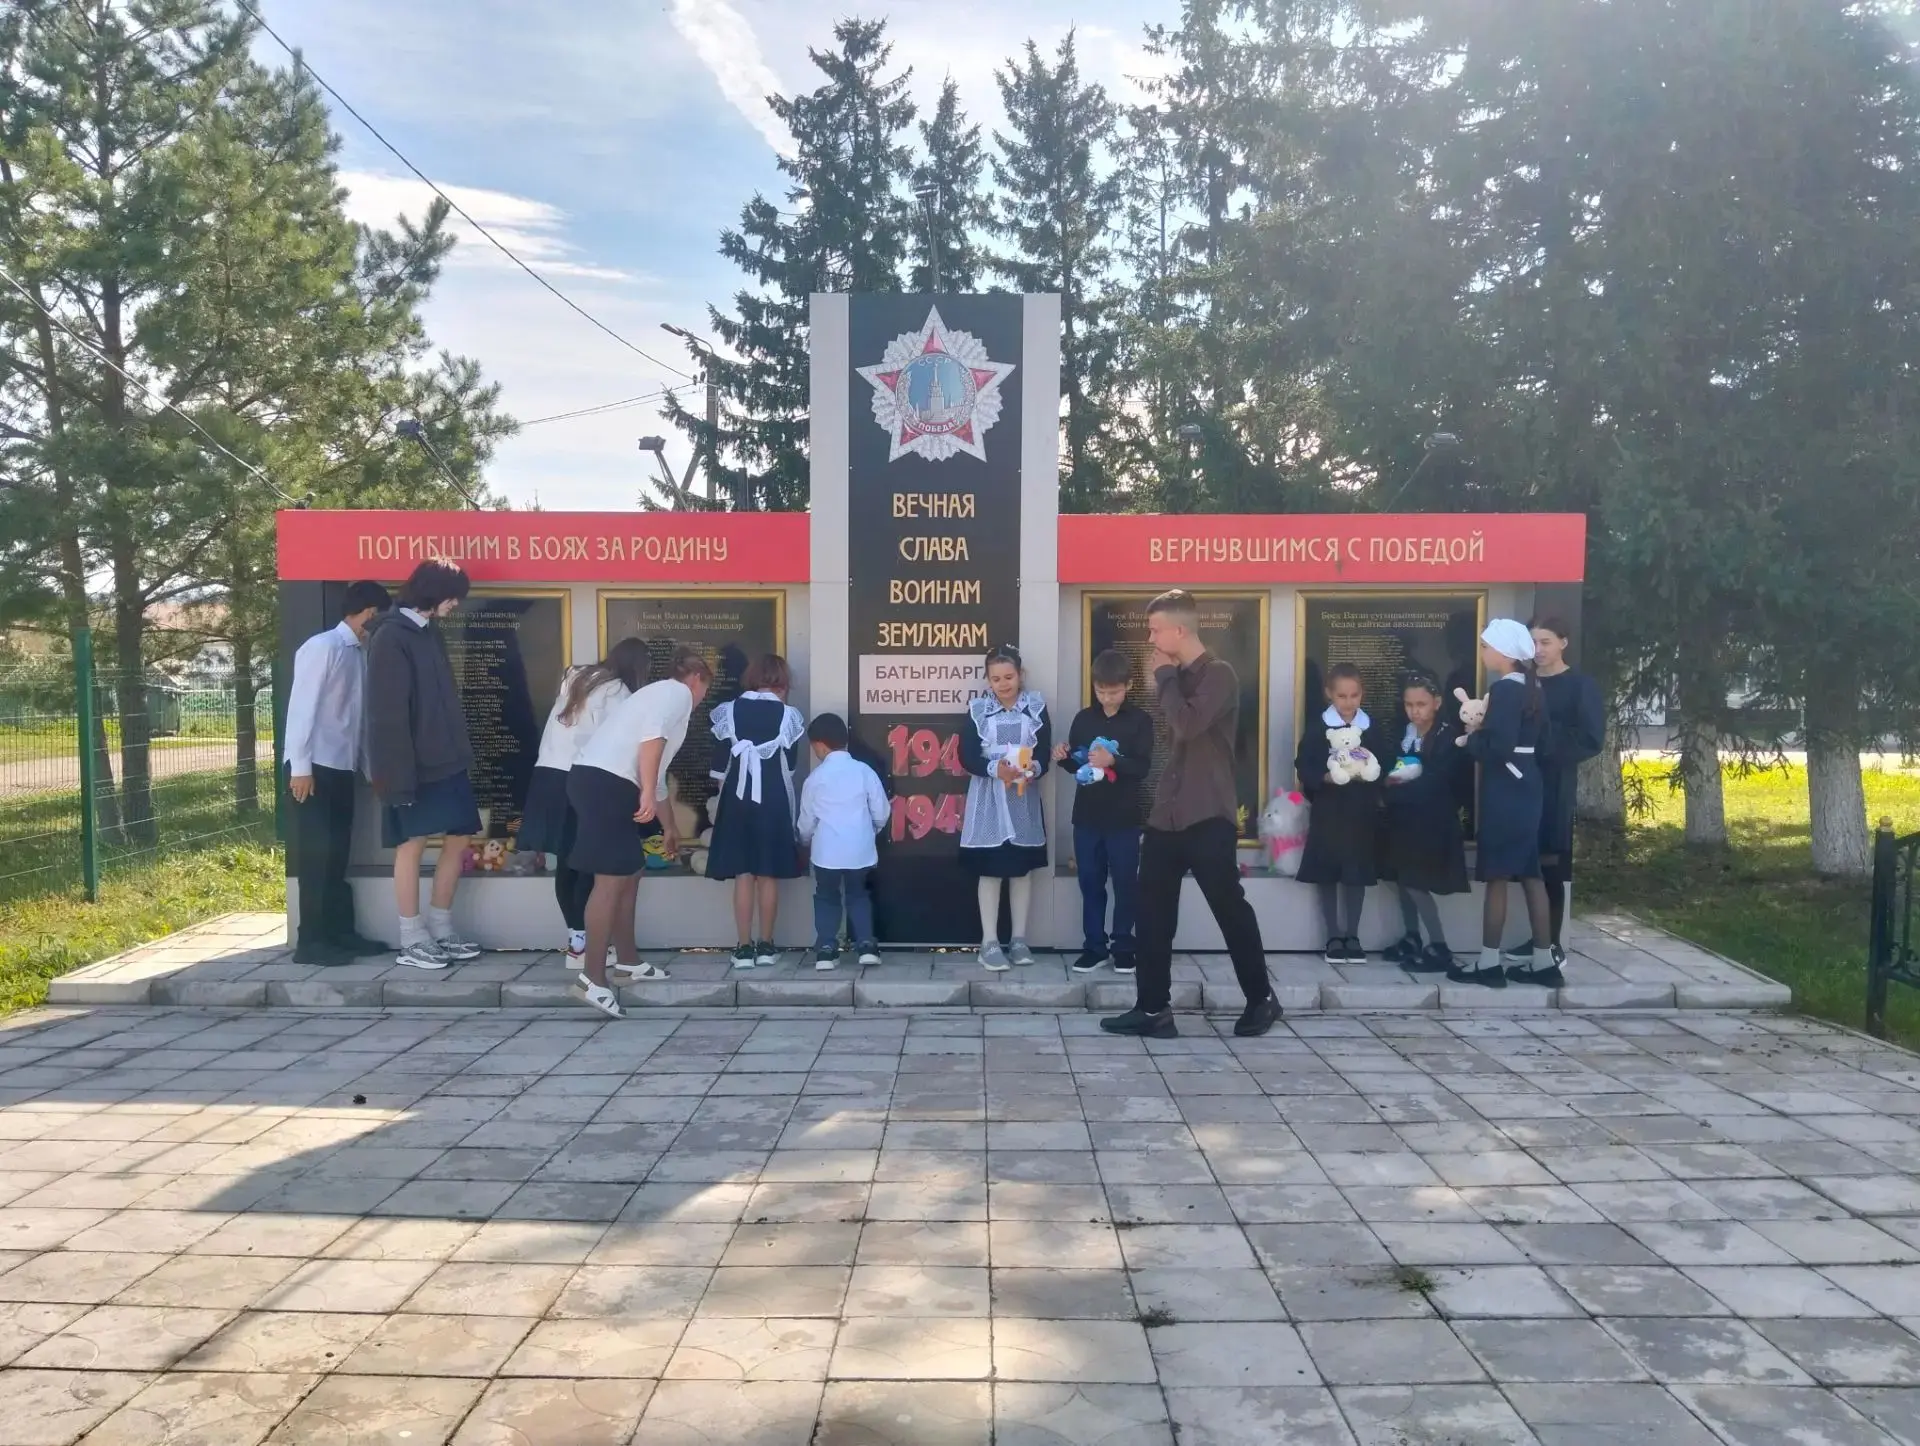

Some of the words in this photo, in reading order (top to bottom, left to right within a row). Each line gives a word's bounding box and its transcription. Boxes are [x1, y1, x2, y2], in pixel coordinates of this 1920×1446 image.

[918, 356, 952, 367] СССР
[918, 421, 956, 433] ПОБЕДА
[892, 493, 975, 518] ВЕЧНАЯ
[358, 535, 501, 561] ПОГИБШИМ
[507, 536, 521, 560] В
[529, 537, 590, 561] БОЯХ
[596, 536, 626, 561] ЗА
[630, 536, 729, 564] РОДИНУ
[900, 537, 970, 561] СЛАВА
[1150, 537, 1340, 562] ВЕРНУВШИМСЯ
[1347, 538, 1362, 562] С
[1369, 530, 1484, 565] ПОБЕДОЙ
[889, 580, 981, 604] ВОИНАМ
[877, 622, 989, 648] ЗЕМЛЯКАМ
[866, 689, 962, 706] МӘҢГЕЛЕК
[887, 724, 966, 778] 194
[889, 793, 966, 842] 194
